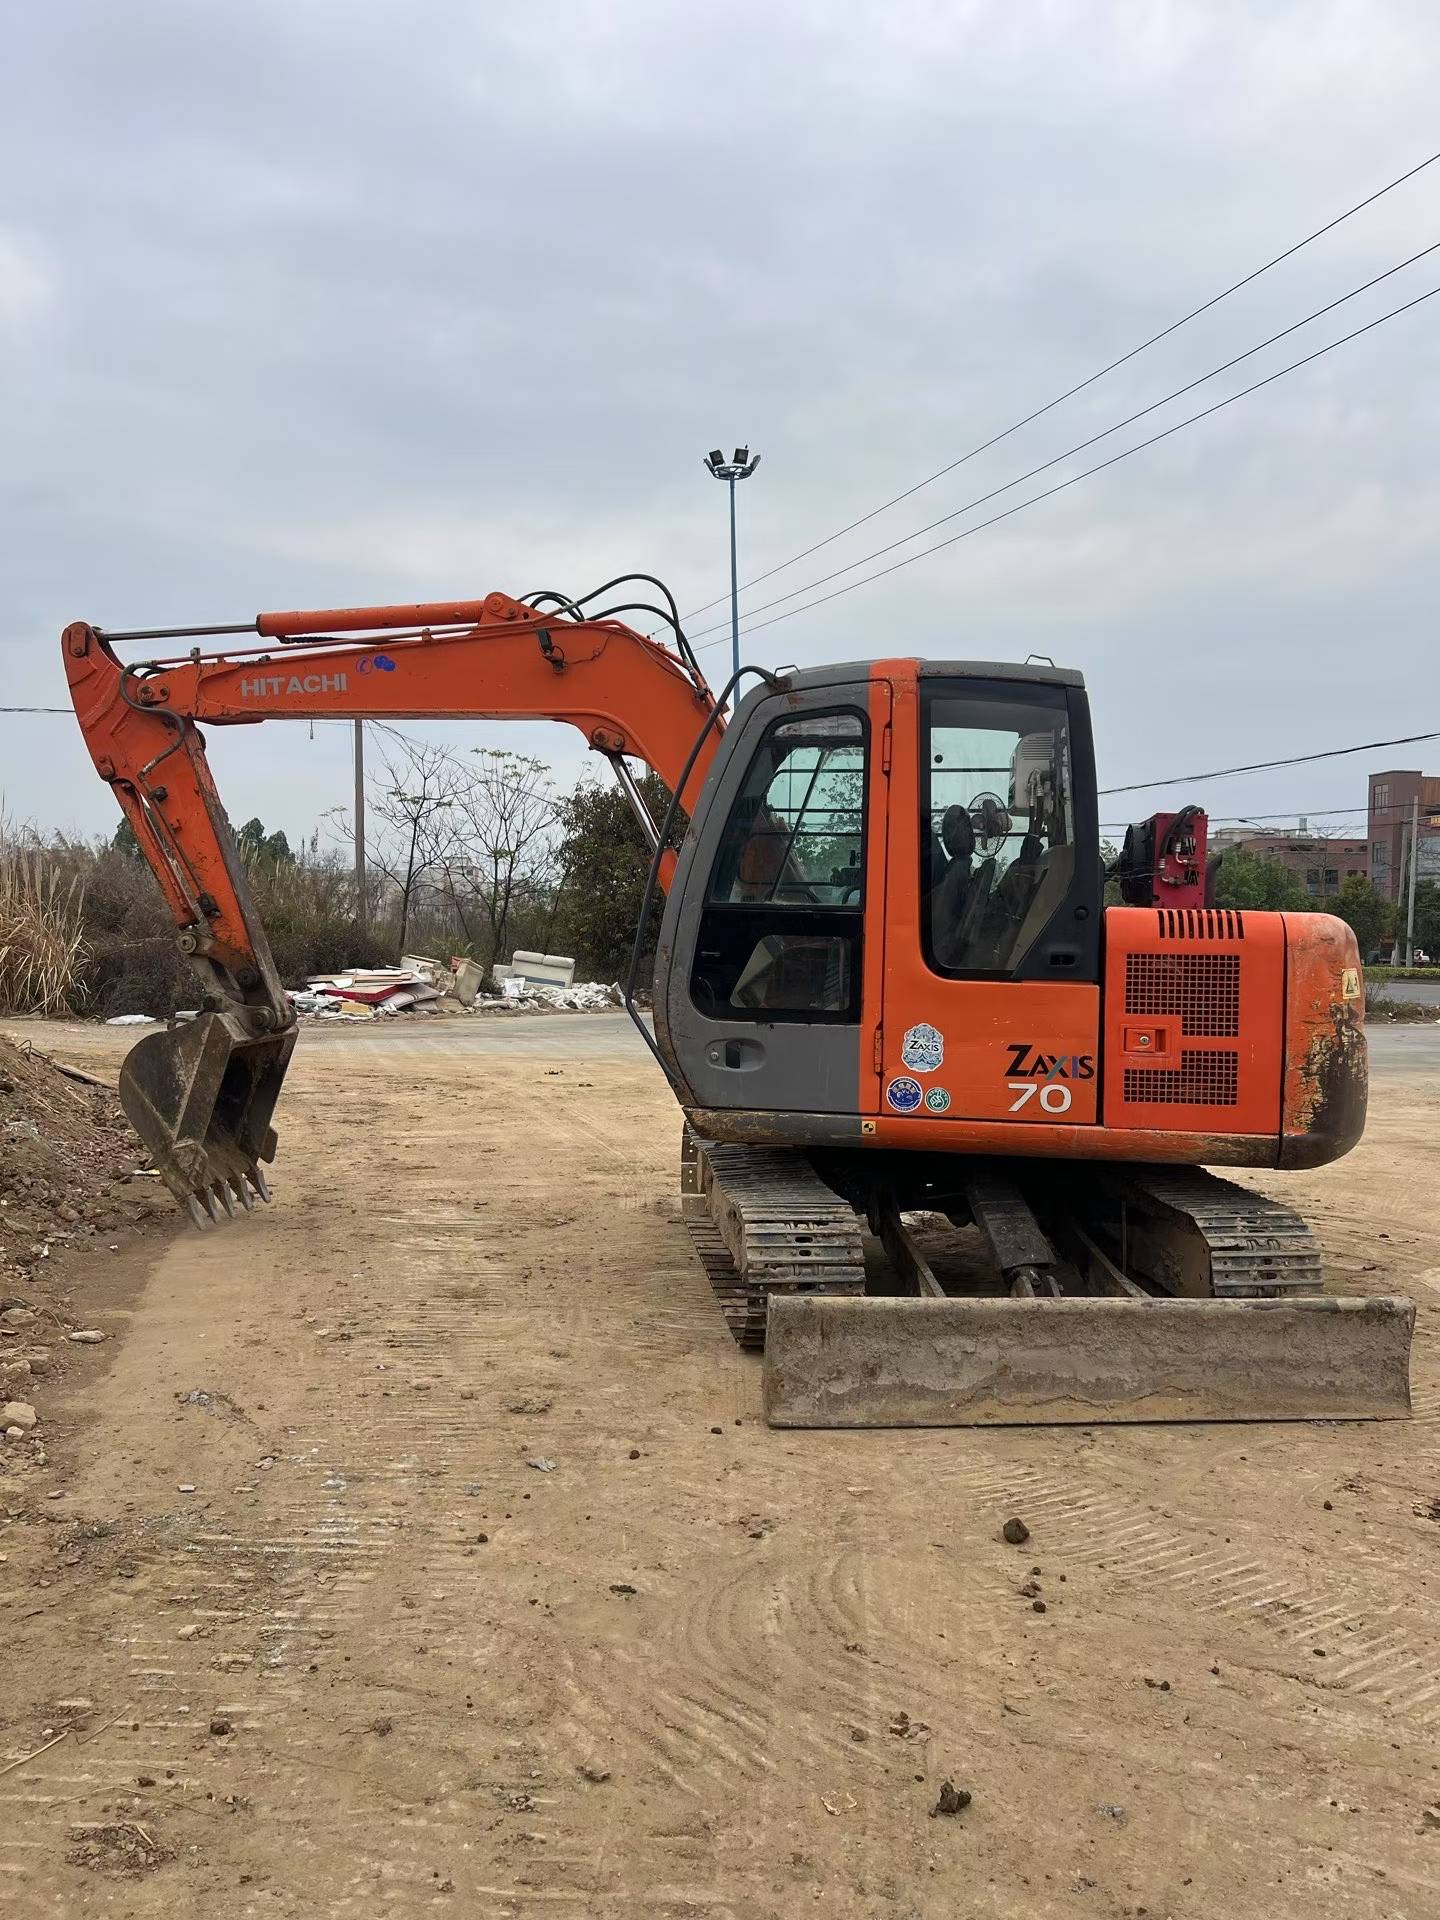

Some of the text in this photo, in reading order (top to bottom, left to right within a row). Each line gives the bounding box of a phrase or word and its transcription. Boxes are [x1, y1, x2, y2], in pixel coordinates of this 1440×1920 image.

[241, 673, 347, 697] HITACHI
[909, 1040, 940, 1052] ZAXIS
[1004, 1044, 1095, 1080] ZAXIS
[1008, 1083, 1072, 1113] 70
